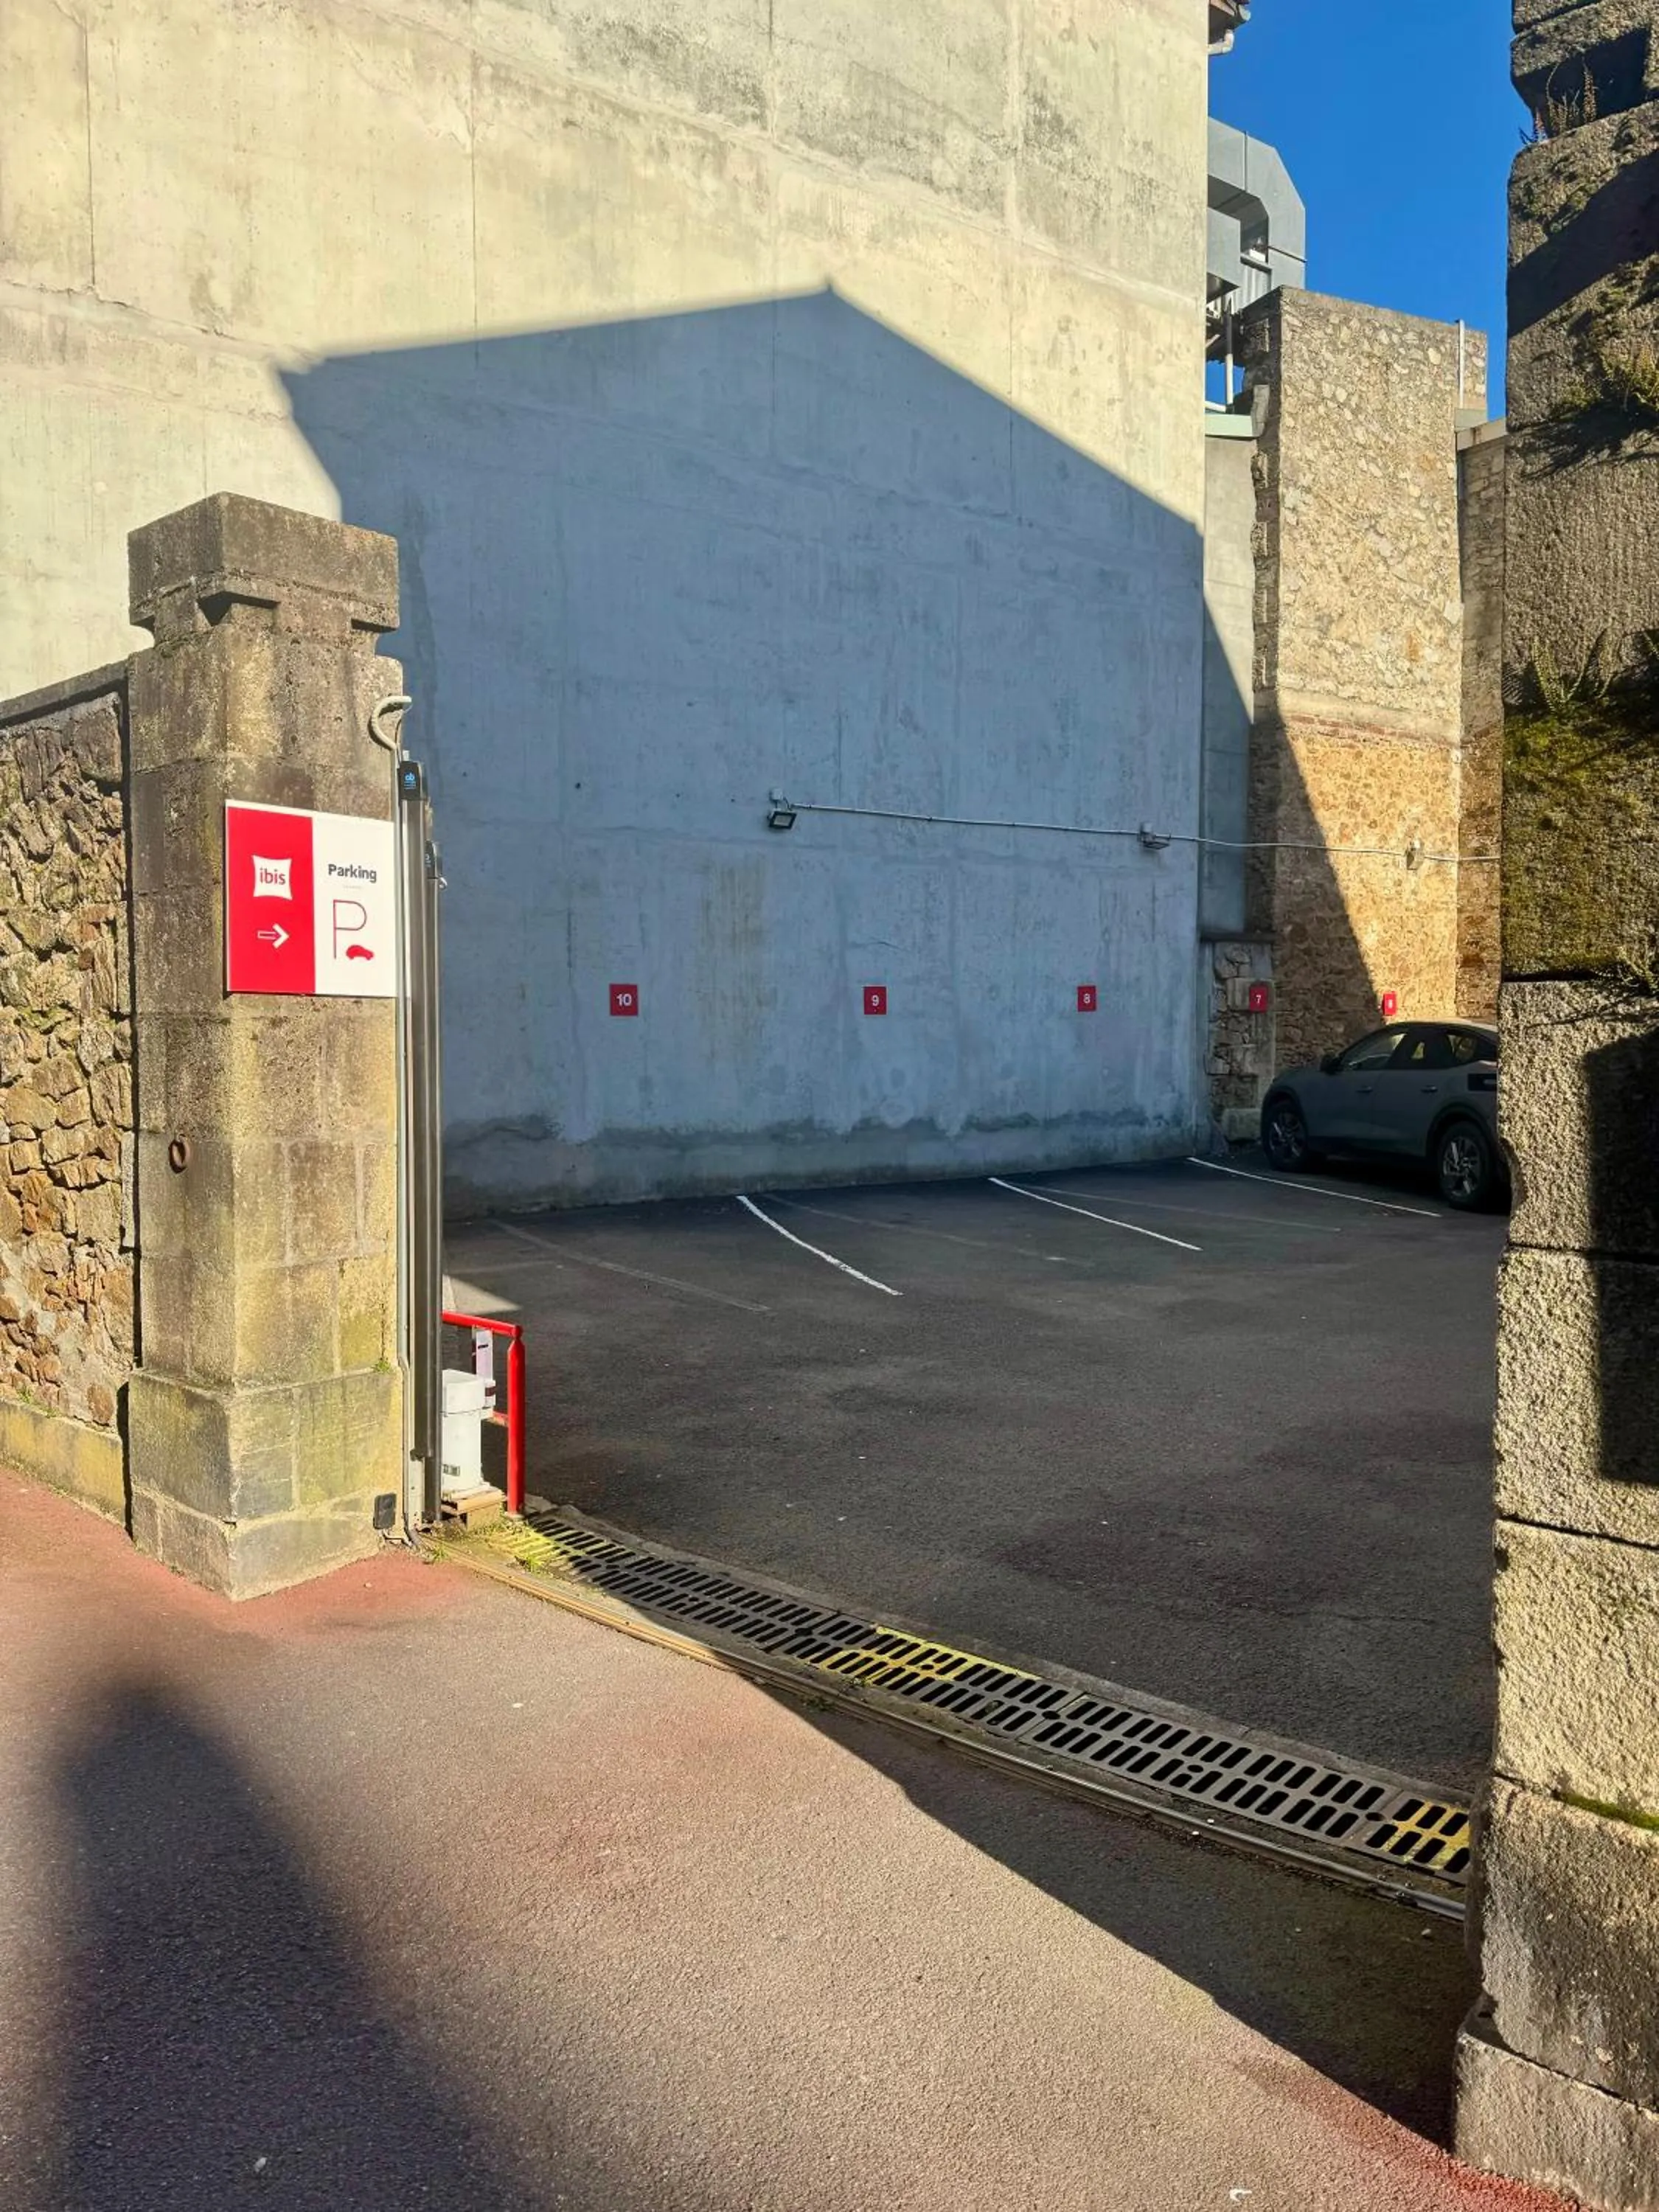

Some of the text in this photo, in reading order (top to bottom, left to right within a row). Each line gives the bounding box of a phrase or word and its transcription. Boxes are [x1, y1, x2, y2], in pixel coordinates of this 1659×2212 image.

[260, 867, 285, 885] ibis
[328, 863, 377, 883] Parking
[616, 993, 632, 1006] 10
[872, 995, 879, 1006] 9
[1084, 993, 1091, 1004] 8
[1256, 995, 1262, 1004] 7
